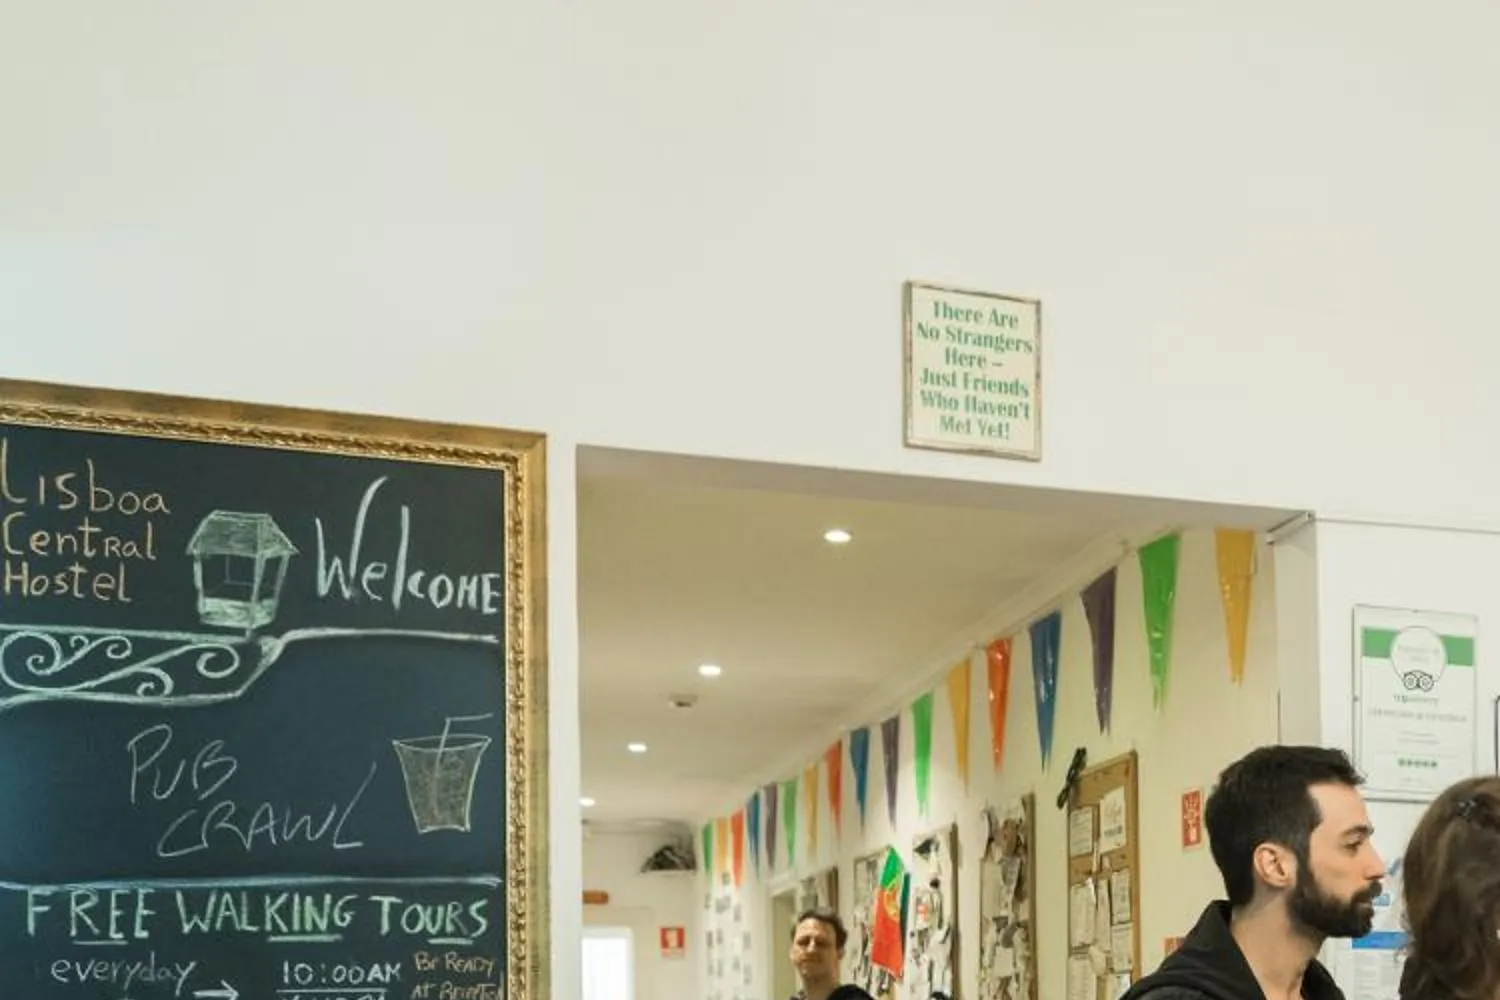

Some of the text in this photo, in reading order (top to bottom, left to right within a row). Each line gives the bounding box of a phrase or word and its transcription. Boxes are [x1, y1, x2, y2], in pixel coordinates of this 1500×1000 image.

[933, 301, 1019, 329] There Are
[916, 321, 1033, 355] No Strangers
[944, 347, 987, 368] Here
[920, 367, 1030, 398] Just Friends
[919, 389, 1030, 421] Who Haven't
[939, 415, 1010, 441] Met Yet!
[0, 436, 171, 514] Lisboa
[3, 561, 132, 603] Hostel
[156, 761, 377, 857] CRAWL
[25, 888, 489, 939] FREE WALKING TOURS
[50, 952, 197, 996] everyday
